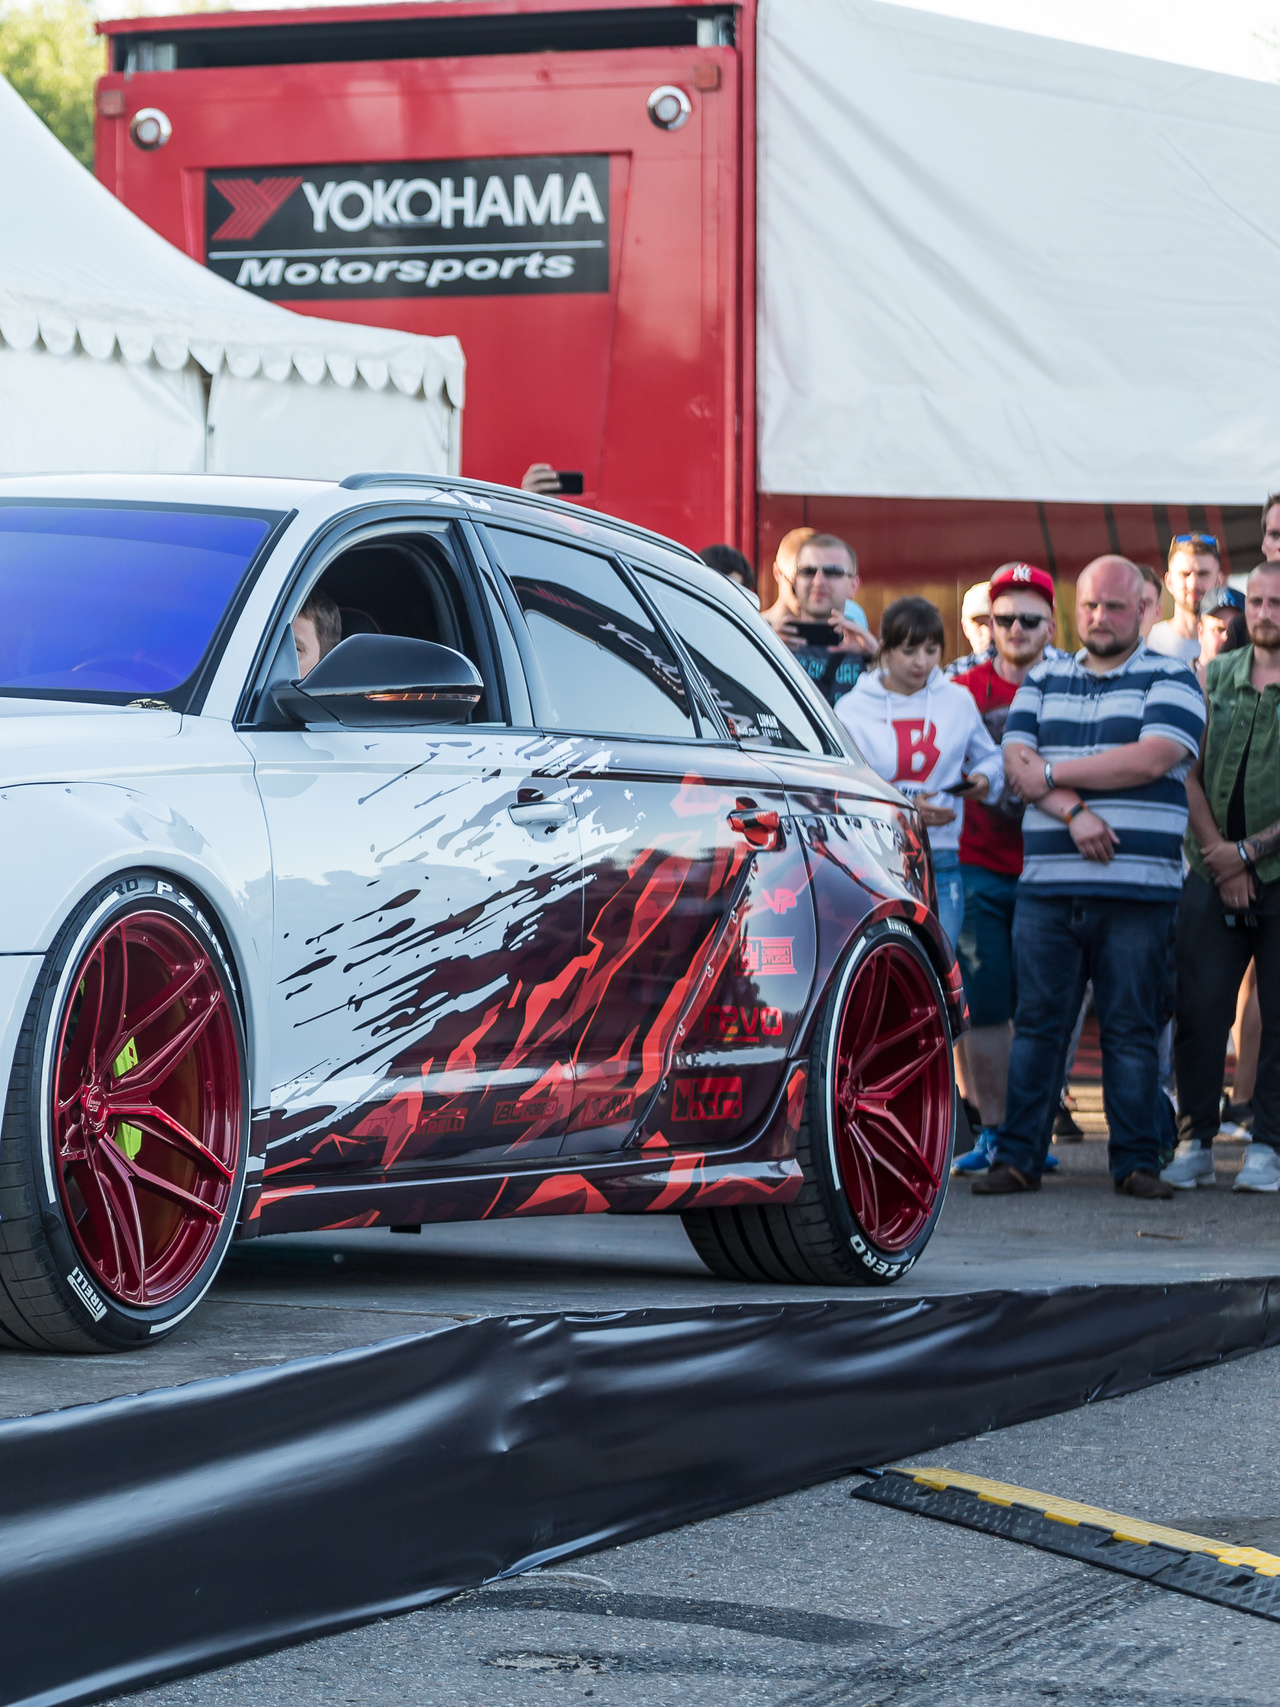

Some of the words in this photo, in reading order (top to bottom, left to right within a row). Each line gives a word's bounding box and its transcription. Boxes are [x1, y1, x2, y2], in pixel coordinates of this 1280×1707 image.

[301, 172, 605, 232] YOKOHAMA
[235, 251, 576, 287] Motorsports
[891, 718, 941, 784] B
[703, 1004, 783, 1036] revo
[849, 1234, 902, 1277] ZERO
[66, 1266, 108, 1322] PIRELLI
